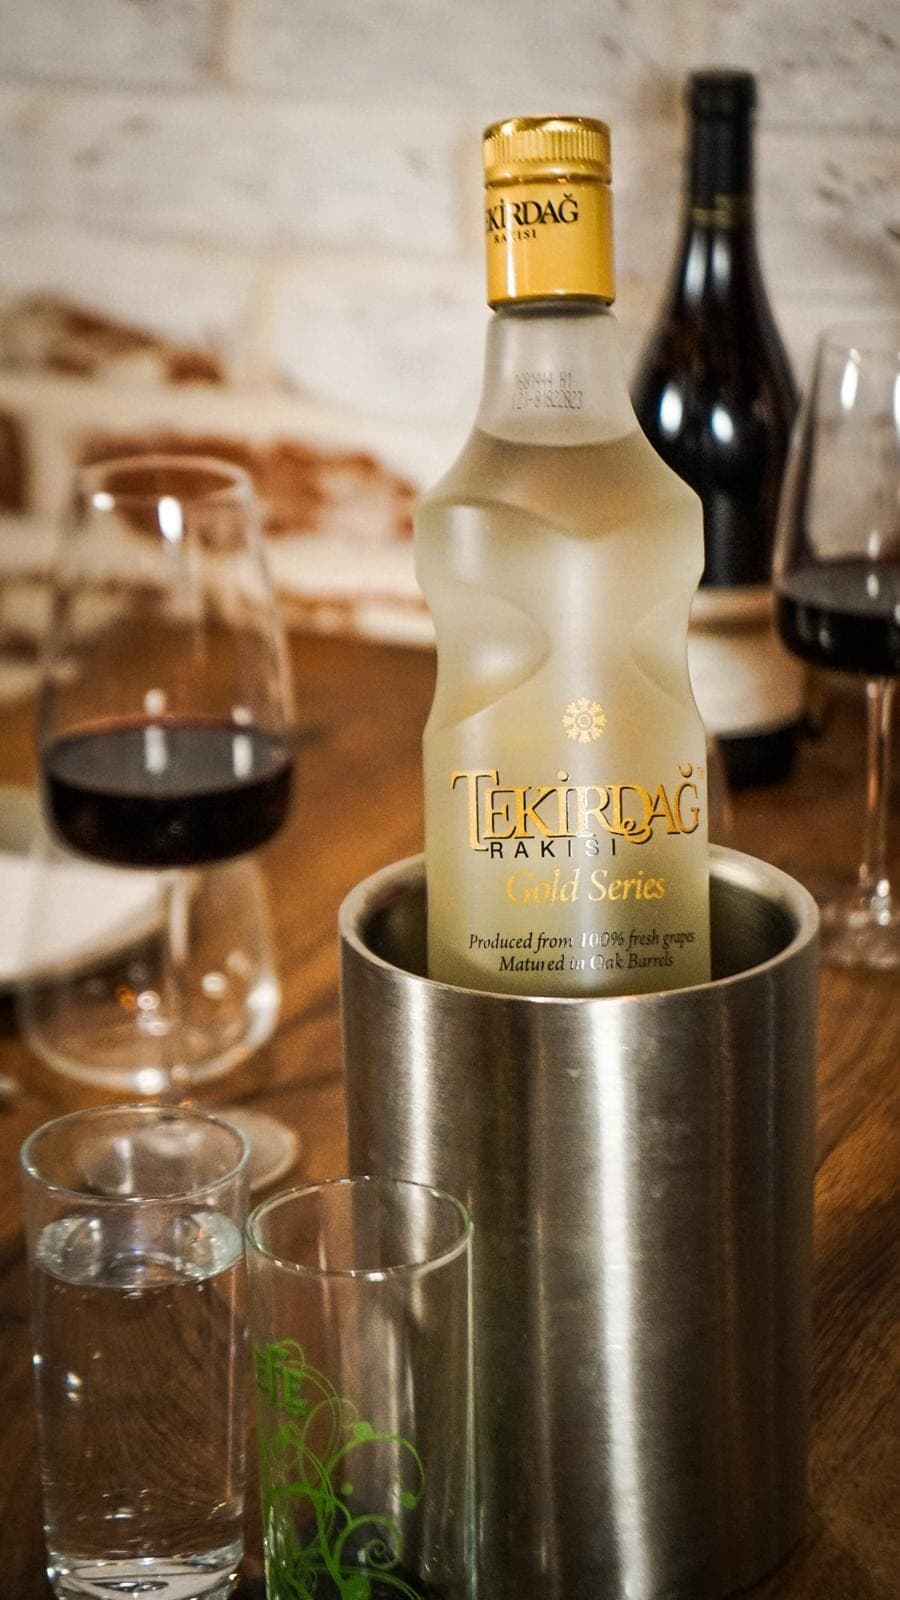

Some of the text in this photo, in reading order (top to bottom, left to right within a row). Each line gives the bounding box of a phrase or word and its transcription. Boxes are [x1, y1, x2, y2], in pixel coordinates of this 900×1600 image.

[487, 192, 579, 231] KİRDAĞ
[450, 763, 700, 852] TEKİRDAĞ
[490, 838, 616, 859] RAKISI
[506, 868, 666, 905] Gold Series
[469, 928, 696, 953] Produced from 100% fresh grapes
[498, 950, 674, 972] Matured in Oak Barrels
